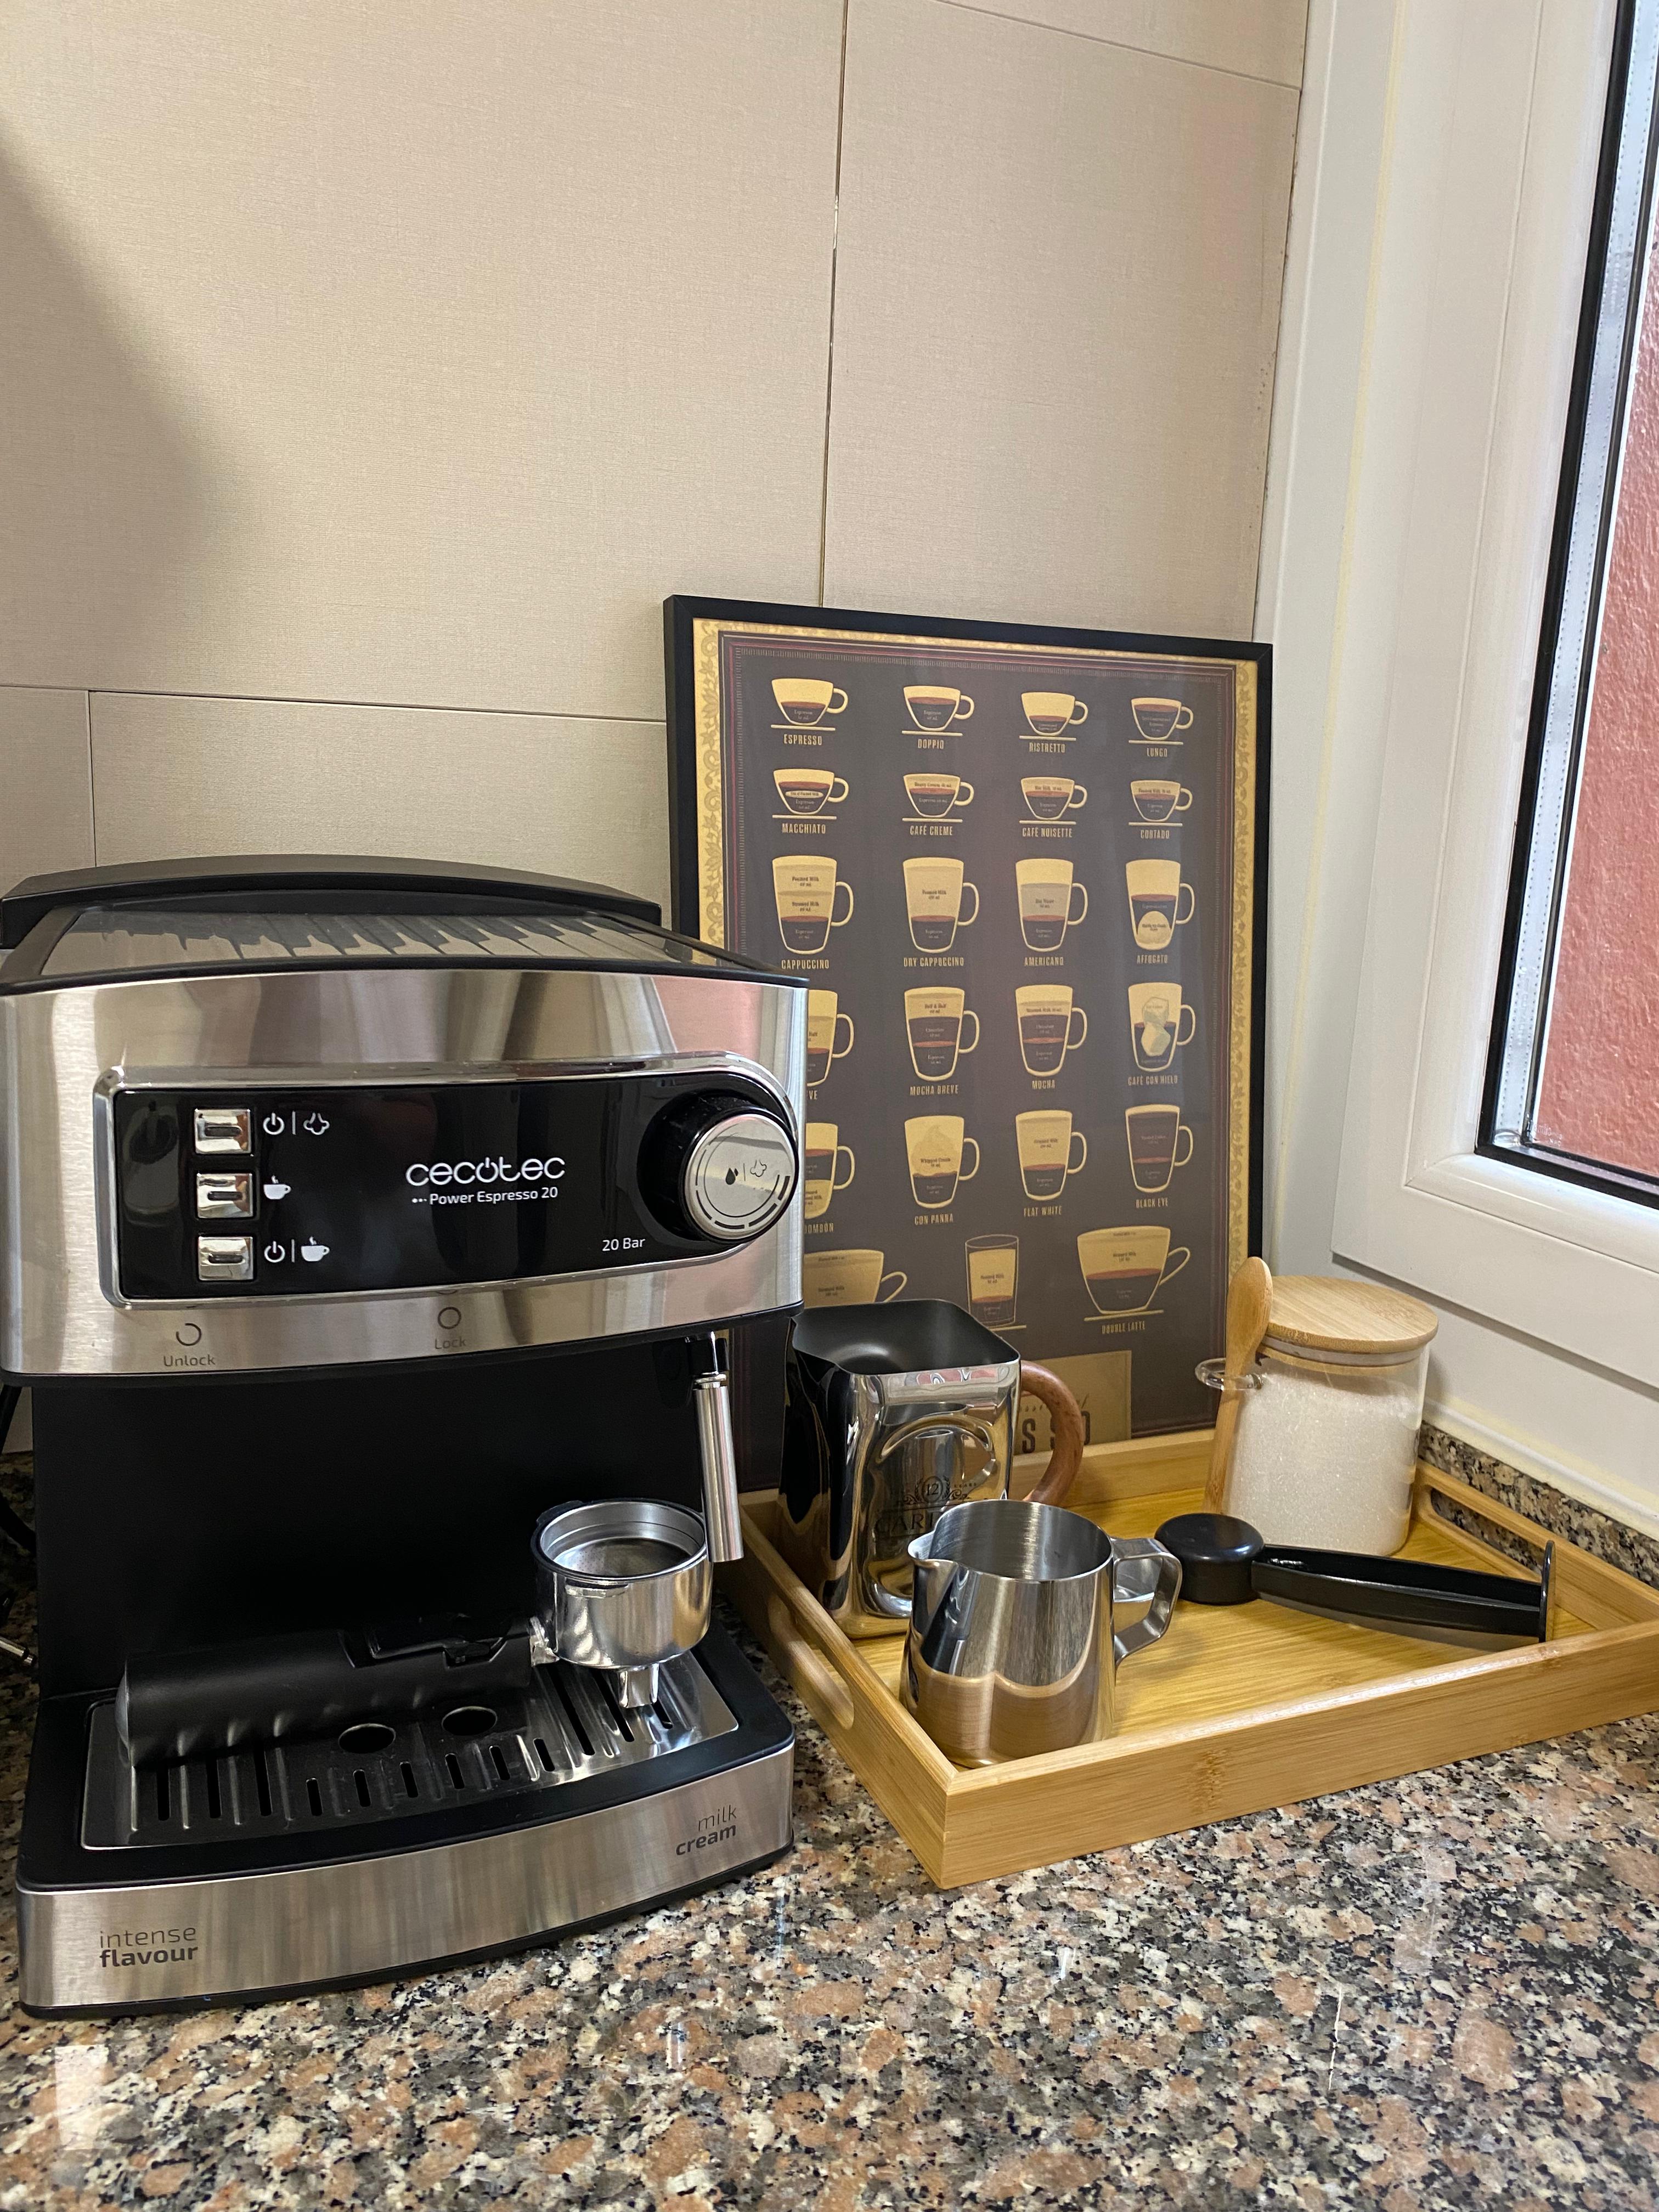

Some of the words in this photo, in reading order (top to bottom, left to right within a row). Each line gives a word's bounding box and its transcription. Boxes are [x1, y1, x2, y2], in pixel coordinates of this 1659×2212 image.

[784, 733, 822, 746] ESPRESSO
[918, 738, 944, 749] DOPPIO
[1029, 742, 1065, 753] RISTRETTO
[1147, 748, 1167, 757] LUNGO
[782, 823, 826, 834] MACCHIATO
[929, 826, 953, 836] CREME
[1041, 828, 1073, 837] NOISETTE
[1141, 830, 1170, 839] CORTADO
[781, 960, 830, 969] CAPPUCCINO
[904, 957, 917, 967] DRY
[919, 957, 964, 967] CAPPUCCINO
[1024, 956, 1064, 966] AMERICANO
[1137, 955, 1168, 964] AFFOGATO
[1032, 1079, 1056, 1090] MOCHA
[1146, 1076, 1158, 1085] CON
[1160, 1075, 1178, 1085] HIELO
[910, 1086, 933, 1096] MOCHA
[937, 1084, 958, 1094] BREVE
[405, 1156, 565, 1186] cecotec
[430, 1191, 475, 1205] Power
[477, 1189, 539, 1204] Espresso
[541, 1186, 558, 1199] 20
[1136, 1199, 1155, 1209] BLACK
[1158, 1198, 1169, 1207] EYE
[1024, 1206, 1038, 1217] FLAT
[1041, 1205, 1062, 1216] WHITE
[915, 1215, 928, 1226] CON
[931, 1213, 953, 1223] PANNA
[602, 1239, 620, 1251] 20
[623, 1237, 646, 1249] Bar
[1102, 1322, 1125, 1334] DOUBLE
[1127, 1321, 1146, 1331] LATTE
[435, 1336, 466, 1350] Lock
[163, 1353, 216, 1367] Unlock
[927, 1482, 939, 1496] 12
[698, 1804, 737, 1832] milk
[675, 1825, 736, 1856] cream
[100, 1927, 196, 1949] intense
[99, 1946, 198, 1968] flavour
